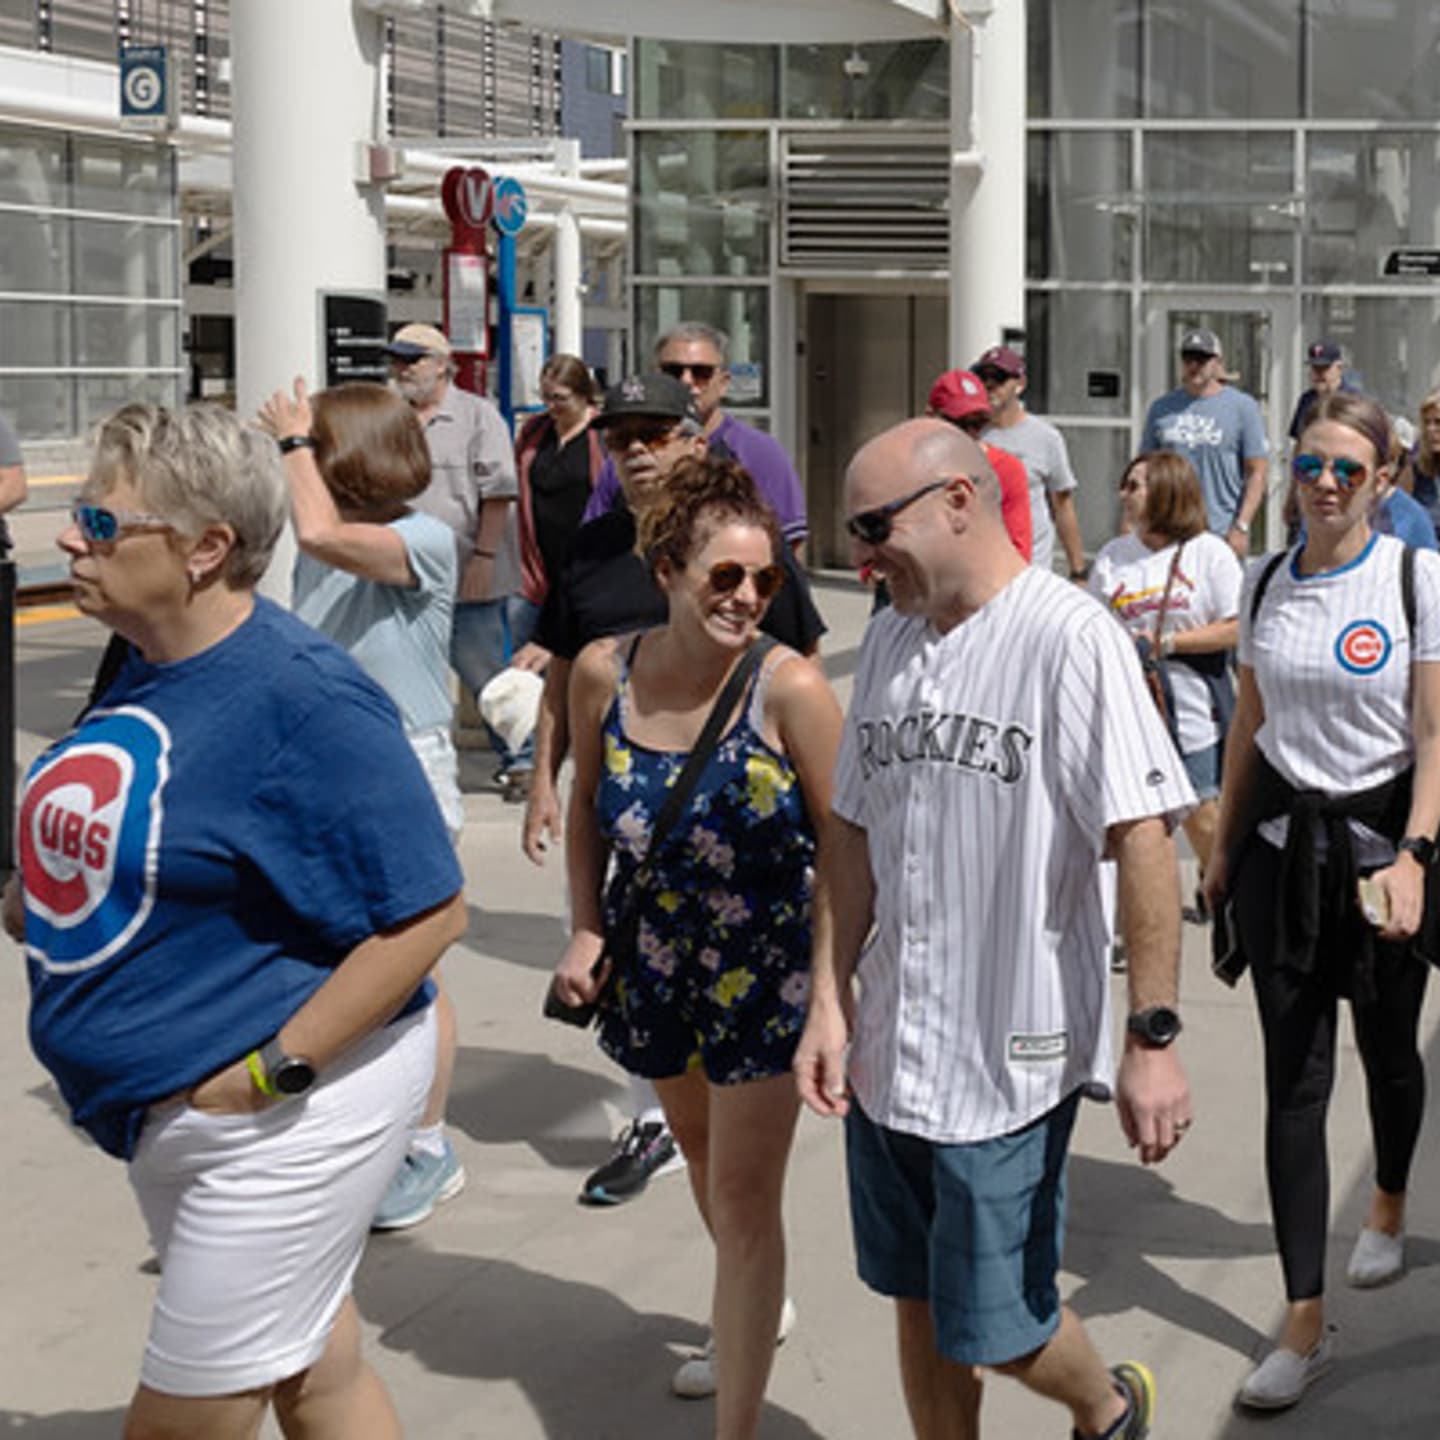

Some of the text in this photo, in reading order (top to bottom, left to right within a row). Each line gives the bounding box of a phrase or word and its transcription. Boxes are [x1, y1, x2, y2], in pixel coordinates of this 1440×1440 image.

[131, 71, 153, 103] G
[465, 177, 490, 222] V
[856, 712, 1035, 788] ROCKIES
